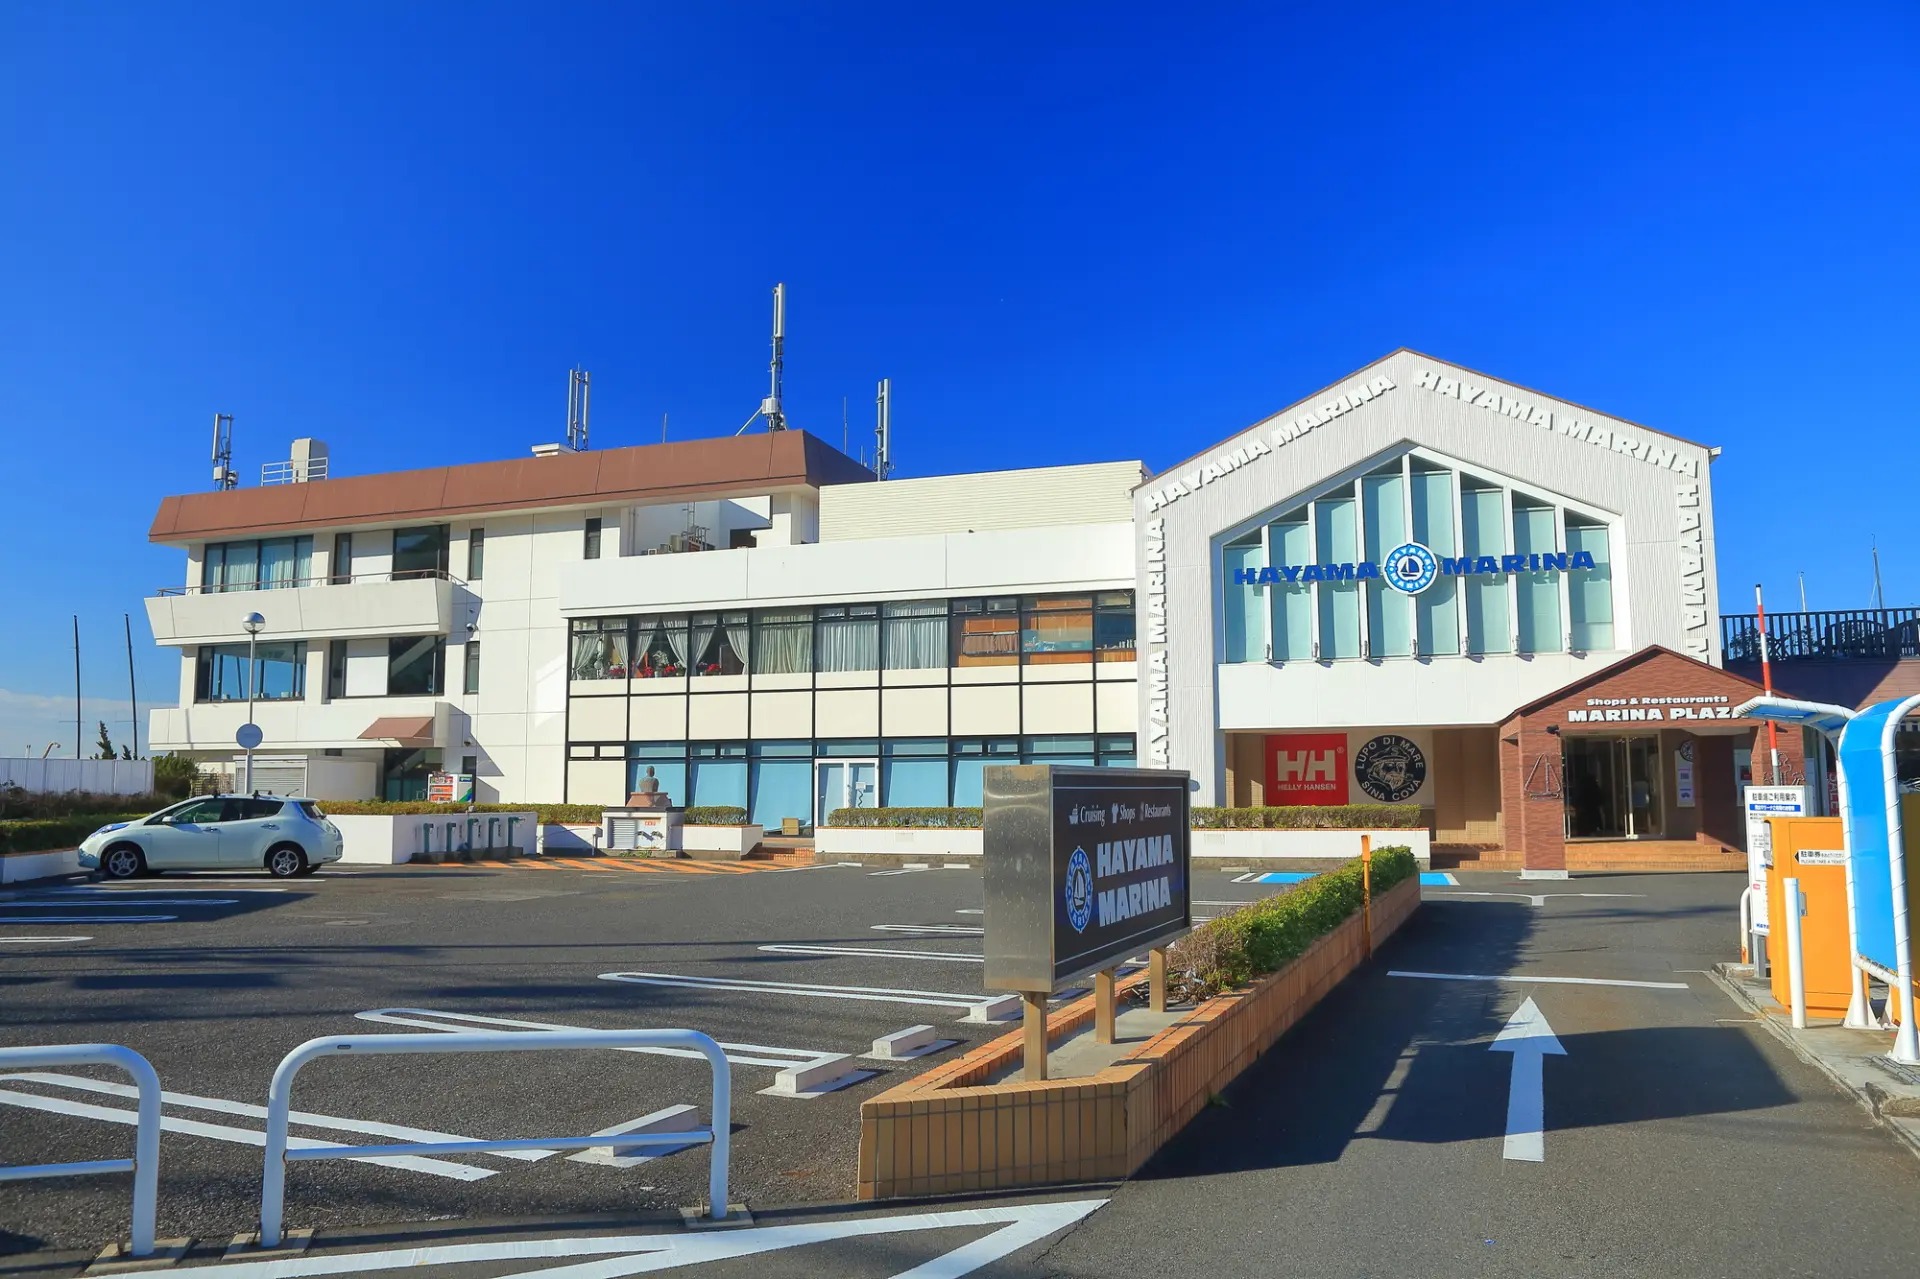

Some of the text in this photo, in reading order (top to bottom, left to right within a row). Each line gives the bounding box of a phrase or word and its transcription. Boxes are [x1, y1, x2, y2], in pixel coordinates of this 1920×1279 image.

[1145, 375, 1397, 513] HAYAMA MARINA
[1413, 370, 1699, 479] HAYAMA MARINA
[1234, 551, 1597, 585] HAYAMA MARINA
[1677, 484, 1707, 631] HAYAMA
[1147, 516, 1169, 770] AYAMA MARINA
[1568, 708, 1664, 722] MARINA
[1586, 695, 1729, 706] Shops & Restaurants
[1357, 737, 1424, 769] LUPO DI MARE
[1361, 779, 1421, 801] SINA COVA
[1080, 803, 1171, 828] Cruising Shops Restaurants
[1097, 834, 1174, 878] HAYAMA
[1098, 876, 1171, 927] MARINA
